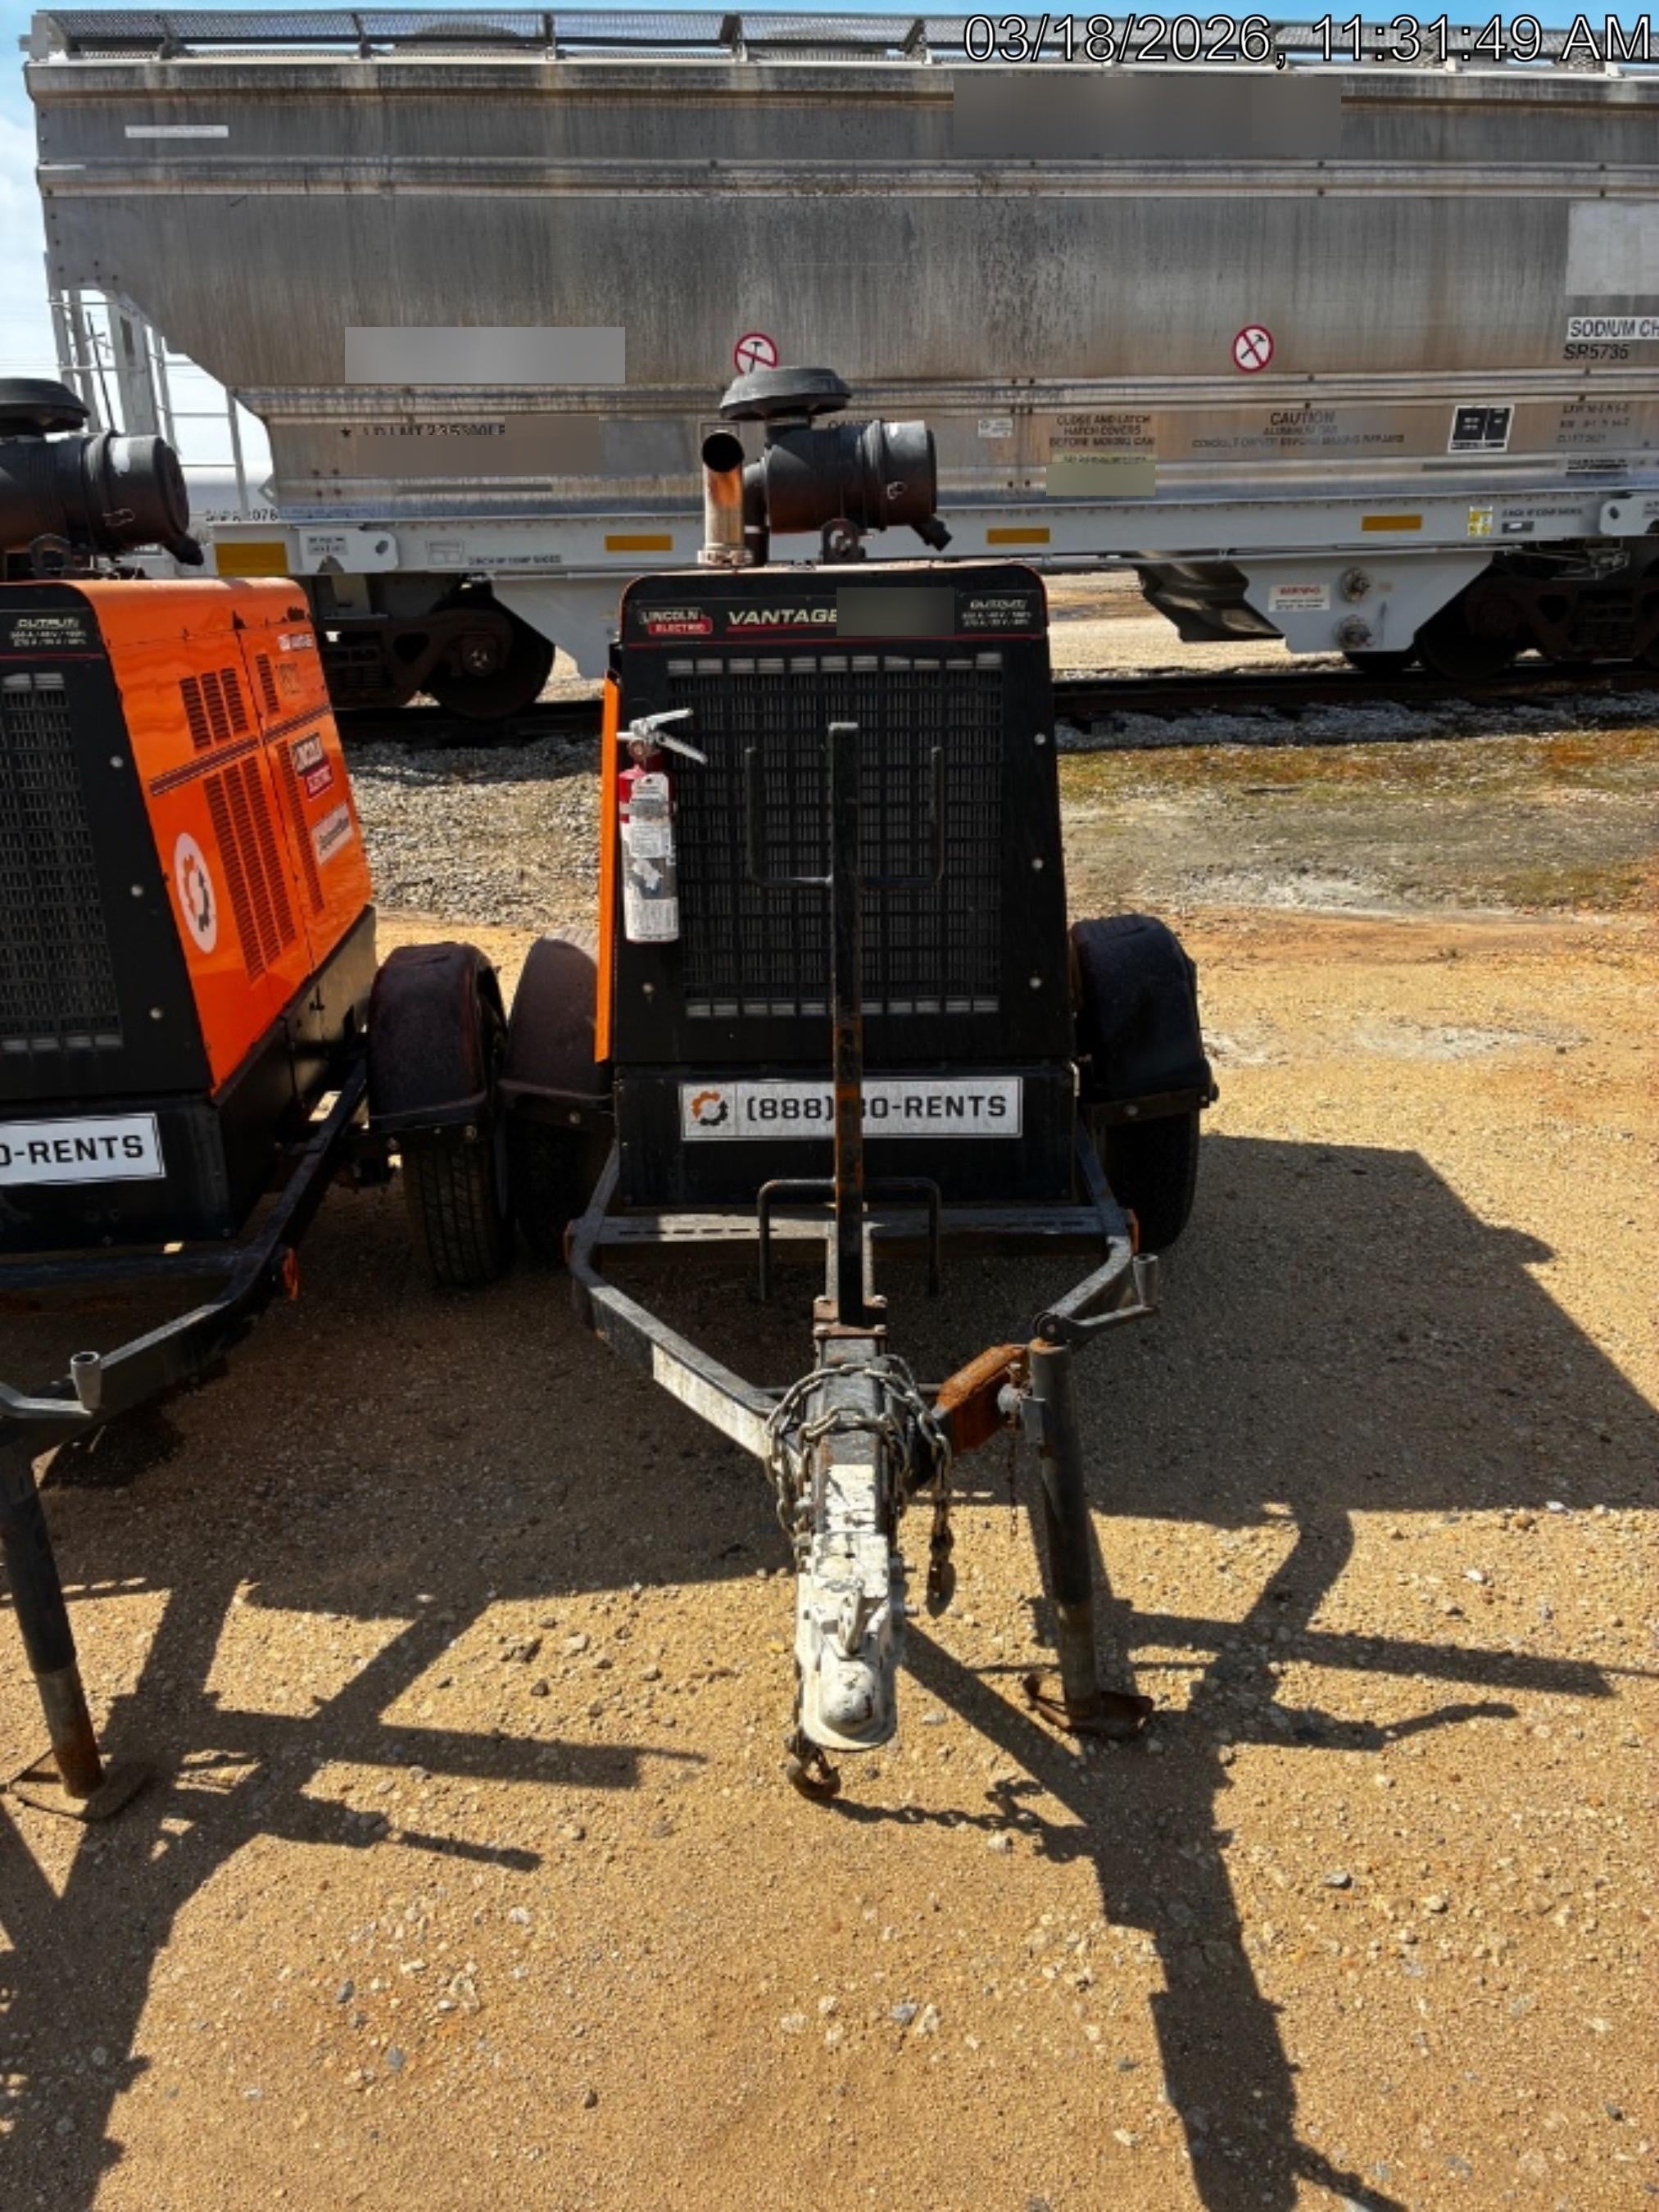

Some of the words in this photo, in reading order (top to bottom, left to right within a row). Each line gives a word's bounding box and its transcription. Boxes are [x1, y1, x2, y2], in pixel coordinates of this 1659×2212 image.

[1571, 319, 1635, 337] SODIUM
[1271, 411, 1336, 425] CAUTION
[746, 1095, 834, 1122] (888)
